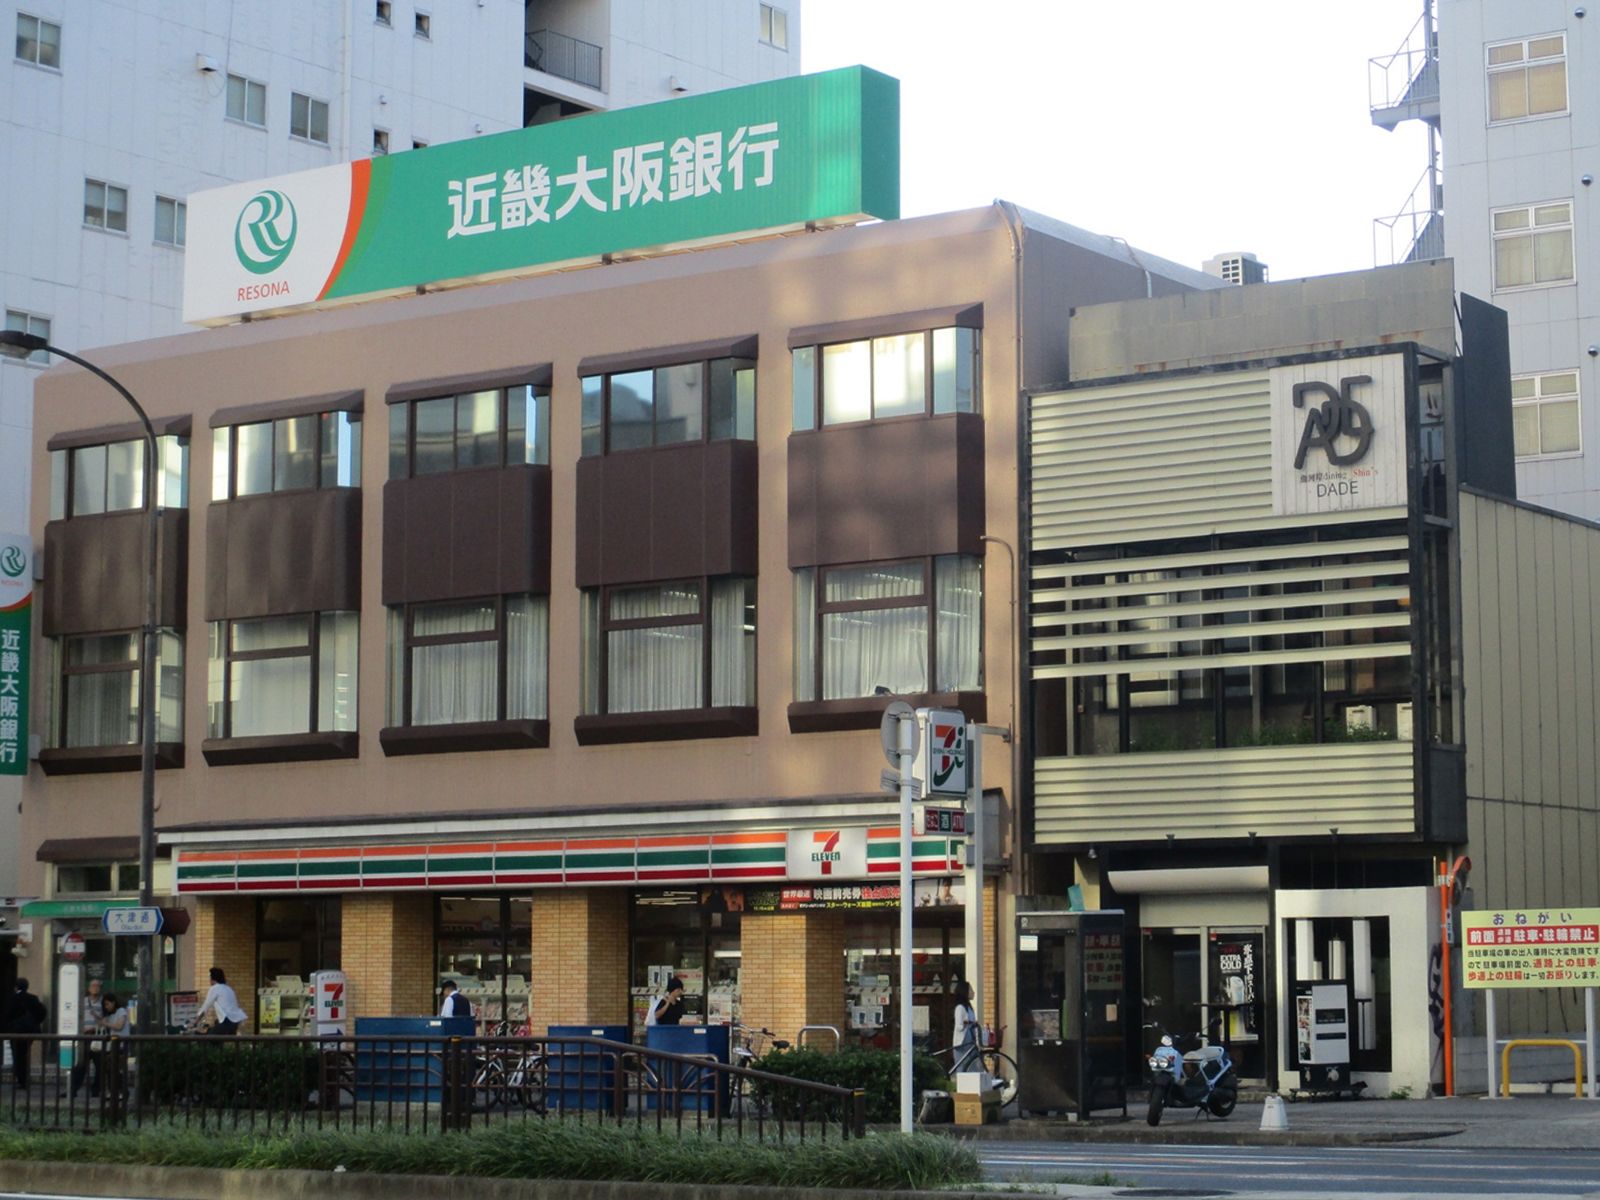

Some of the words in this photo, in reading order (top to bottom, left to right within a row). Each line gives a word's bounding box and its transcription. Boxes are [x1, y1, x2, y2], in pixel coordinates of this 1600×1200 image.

[447, 122, 780, 239] 近畿大阪銀行
[237, 281, 290, 302] RESONA
[1316, 481, 1359, 497] DADE
[0, 629, 20, 762] 近畿大阪銀行
[115, 912, 149, 923] 大津通
[1493, 913, 1572, 925] おねがい
[1220, 961, 1242, 970] COLD
